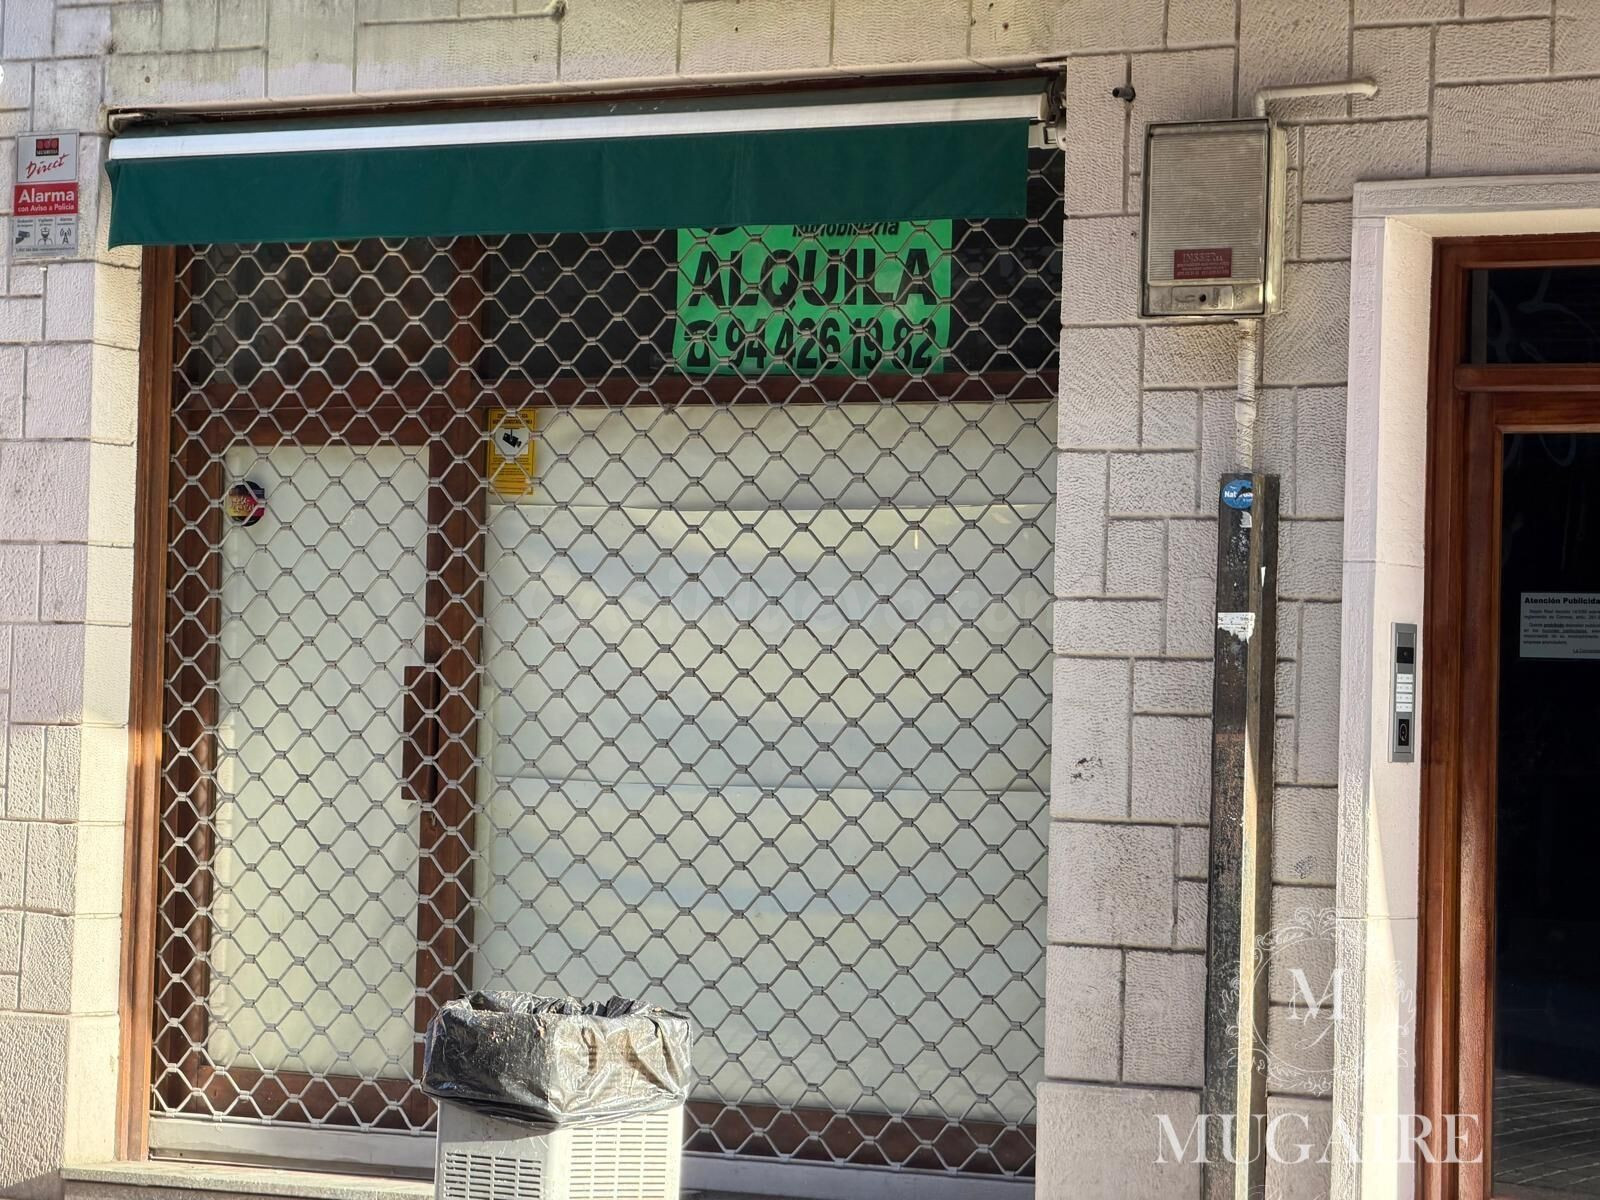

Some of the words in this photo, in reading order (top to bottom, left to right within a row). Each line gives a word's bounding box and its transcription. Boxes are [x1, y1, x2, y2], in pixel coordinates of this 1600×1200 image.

[26, 153, 69, 179] Direct
[18, 187, 75, 203] Alarma
[30, 204, 48, 212] Aviso
[688, 248, 938, 310] ALQUILA
[725, 318, 767, 370] 94
[774, 318, 841, 370] 426
[1524, 597, 1561, 605] Atención
